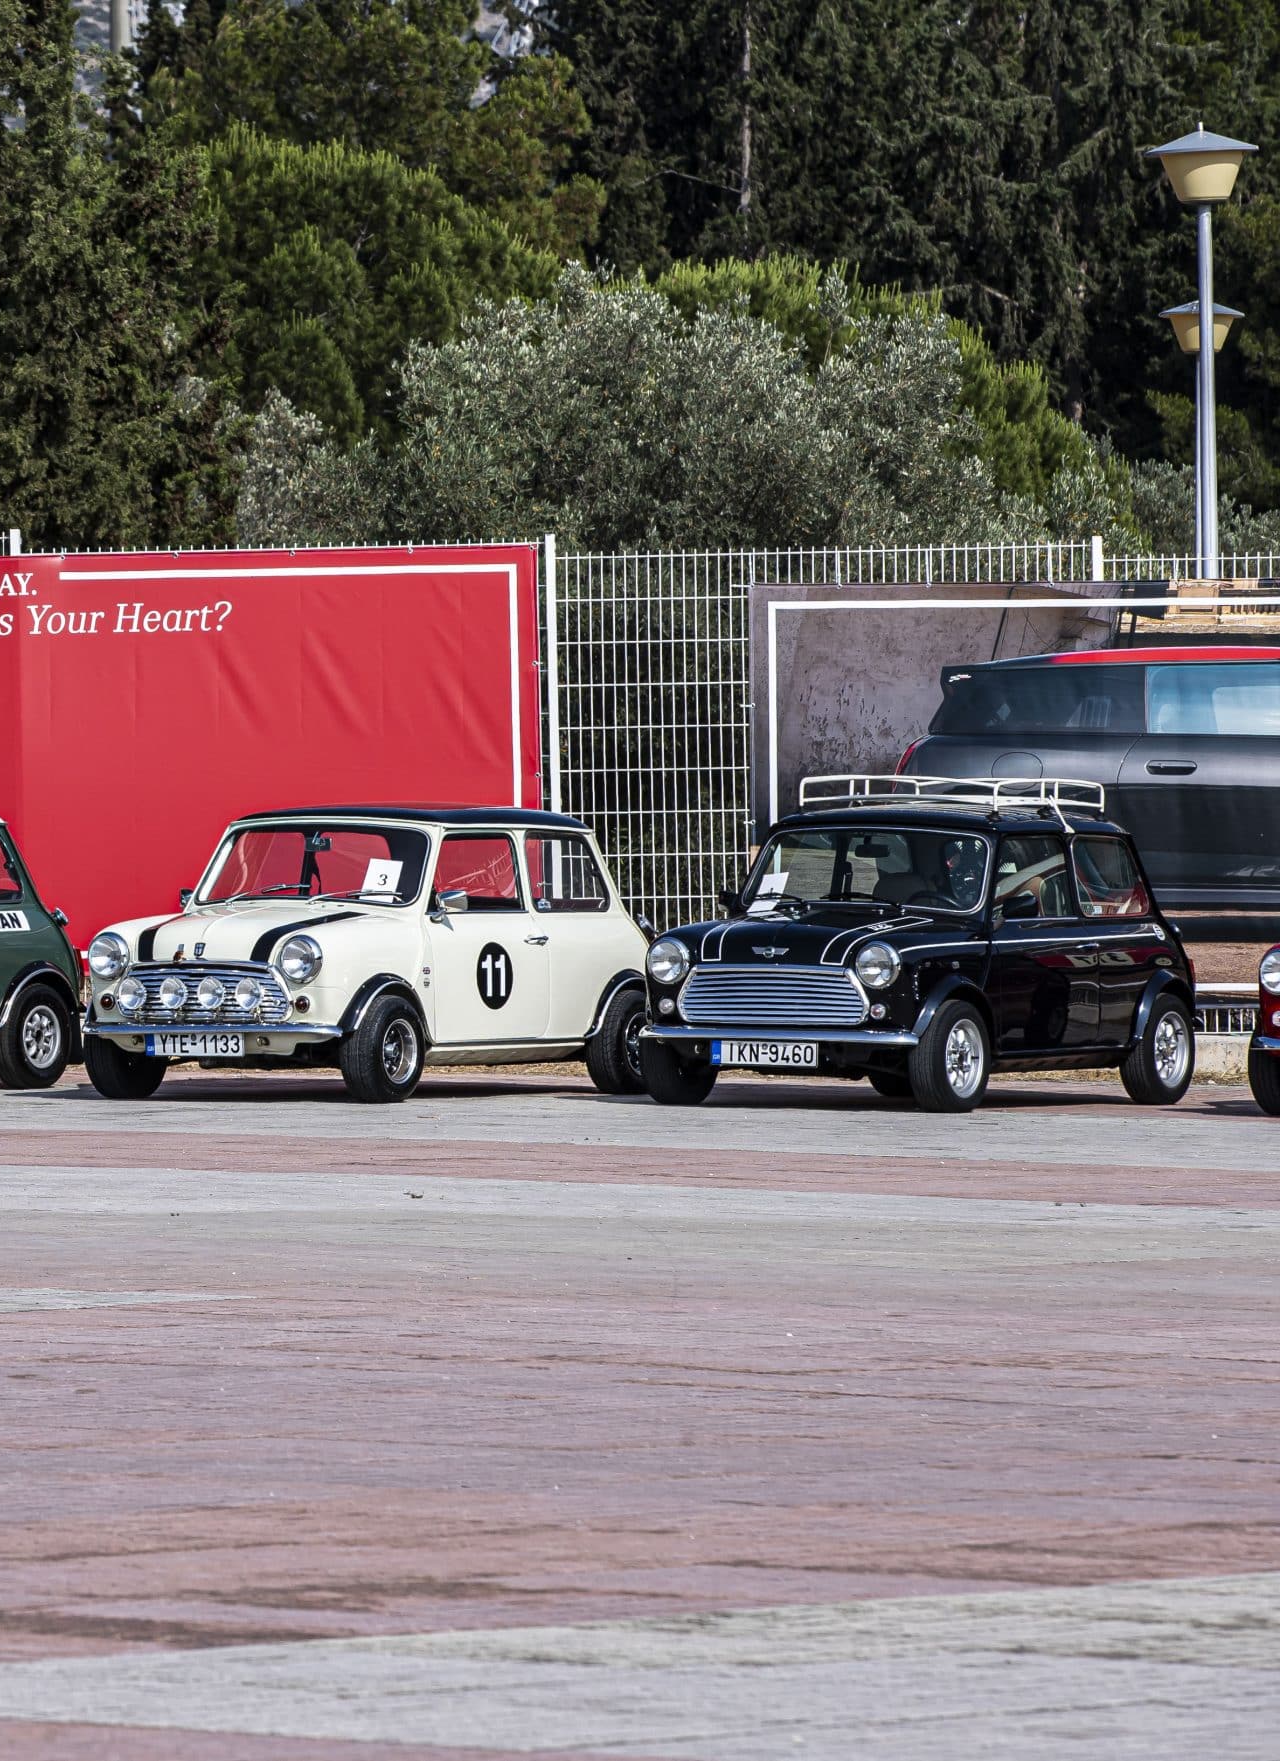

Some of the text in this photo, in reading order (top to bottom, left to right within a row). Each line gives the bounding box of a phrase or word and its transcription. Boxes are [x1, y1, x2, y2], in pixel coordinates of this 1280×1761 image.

[26, 604, 105, 635] Your
[112, 600, 233, 633] Heart?
[376, 873, 388, 886] 3
[481, 953, 506, 998] 11
